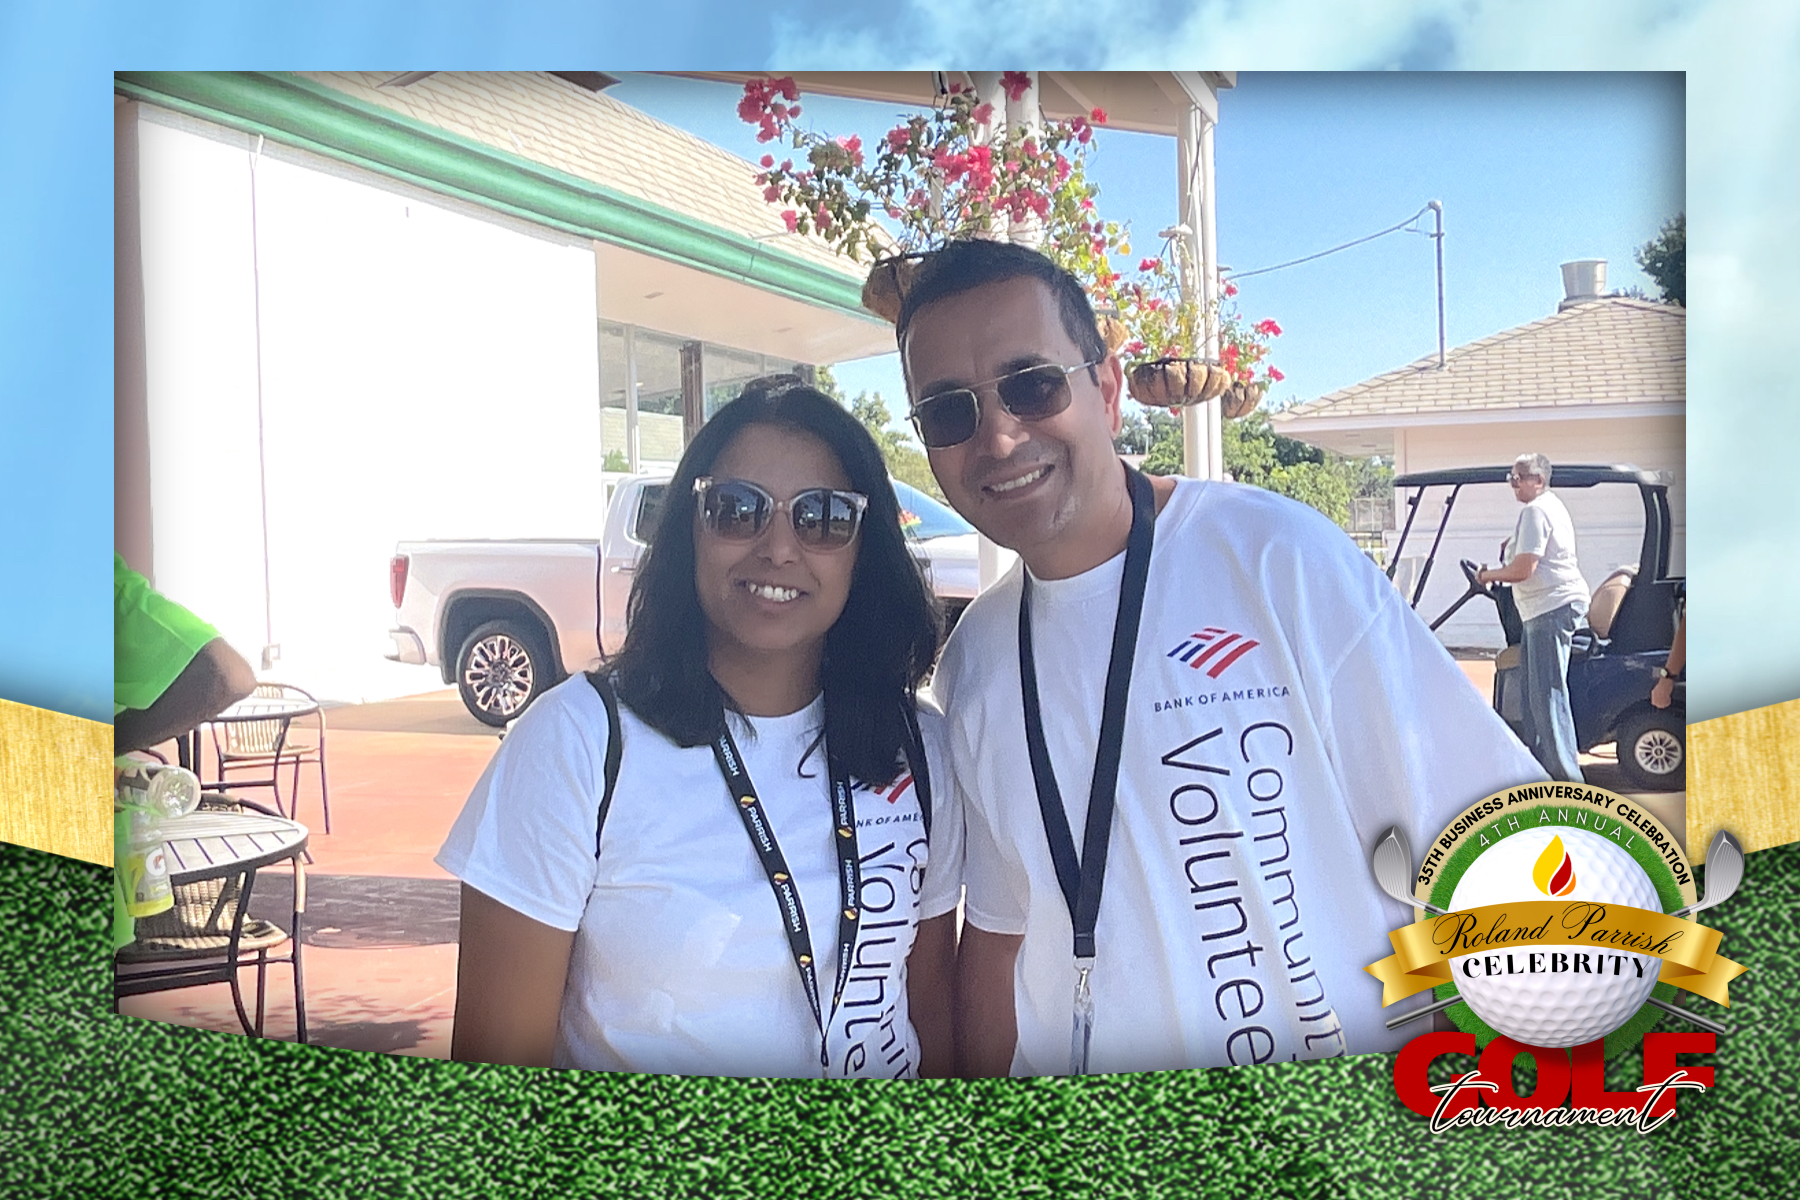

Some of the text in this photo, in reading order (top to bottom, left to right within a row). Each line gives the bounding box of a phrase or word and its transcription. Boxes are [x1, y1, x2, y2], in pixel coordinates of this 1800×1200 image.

[1154, 686, 1290, 712] BANK OF AMERICA
[720, 735, 740, 777] ARRISH
[837, 781, 849, 826] PARRISH
[876, 816, 891, 826] OF
[748, 806, 773, 853] PARRISH
[844, 859, 856, 907] PARRISH
[1161, 727, 1297, 1067] Voluntee
[1240, 721, 1345, 1058] Communit
[781, 883, 801, 933] PARRISH
